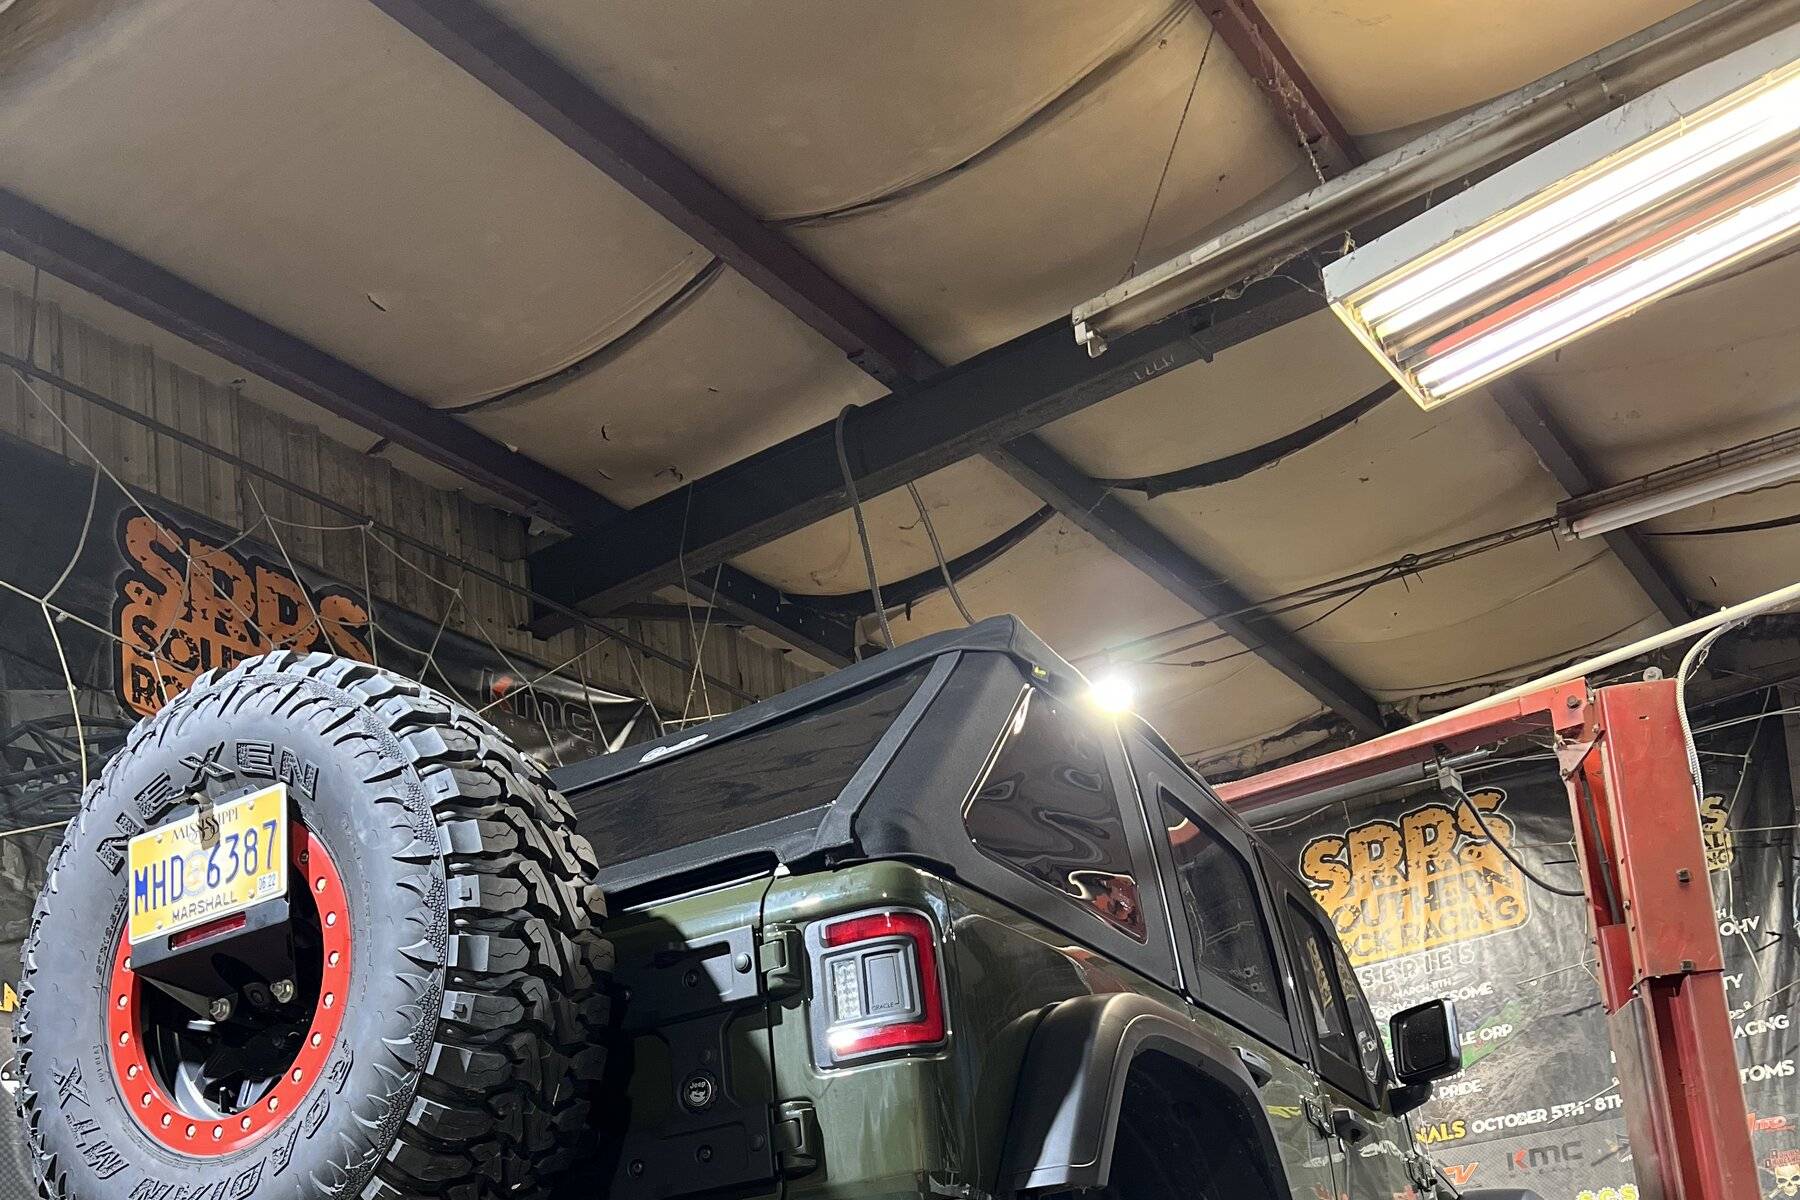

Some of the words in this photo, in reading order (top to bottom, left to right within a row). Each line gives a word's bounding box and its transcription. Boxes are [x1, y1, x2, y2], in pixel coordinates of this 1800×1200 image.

[96, 739, 319, 877] NEXEN
[134, 854, 184, 916] MHD
[206, 818, 278, 890] 6387
[1302, 789, 1513, 902] SRRS
[172, 893, 238, 923] MARSHALL
[1331, 860, 1514, 934] OUTHERN
[1359, 943, 1477, 988] SERIES
[1733, 1014, 1790, 1040] ACING
[1439, 1079, 1483, 1100] PRIDE
[1471, 1108, 1548, 1134] OCTOBER
